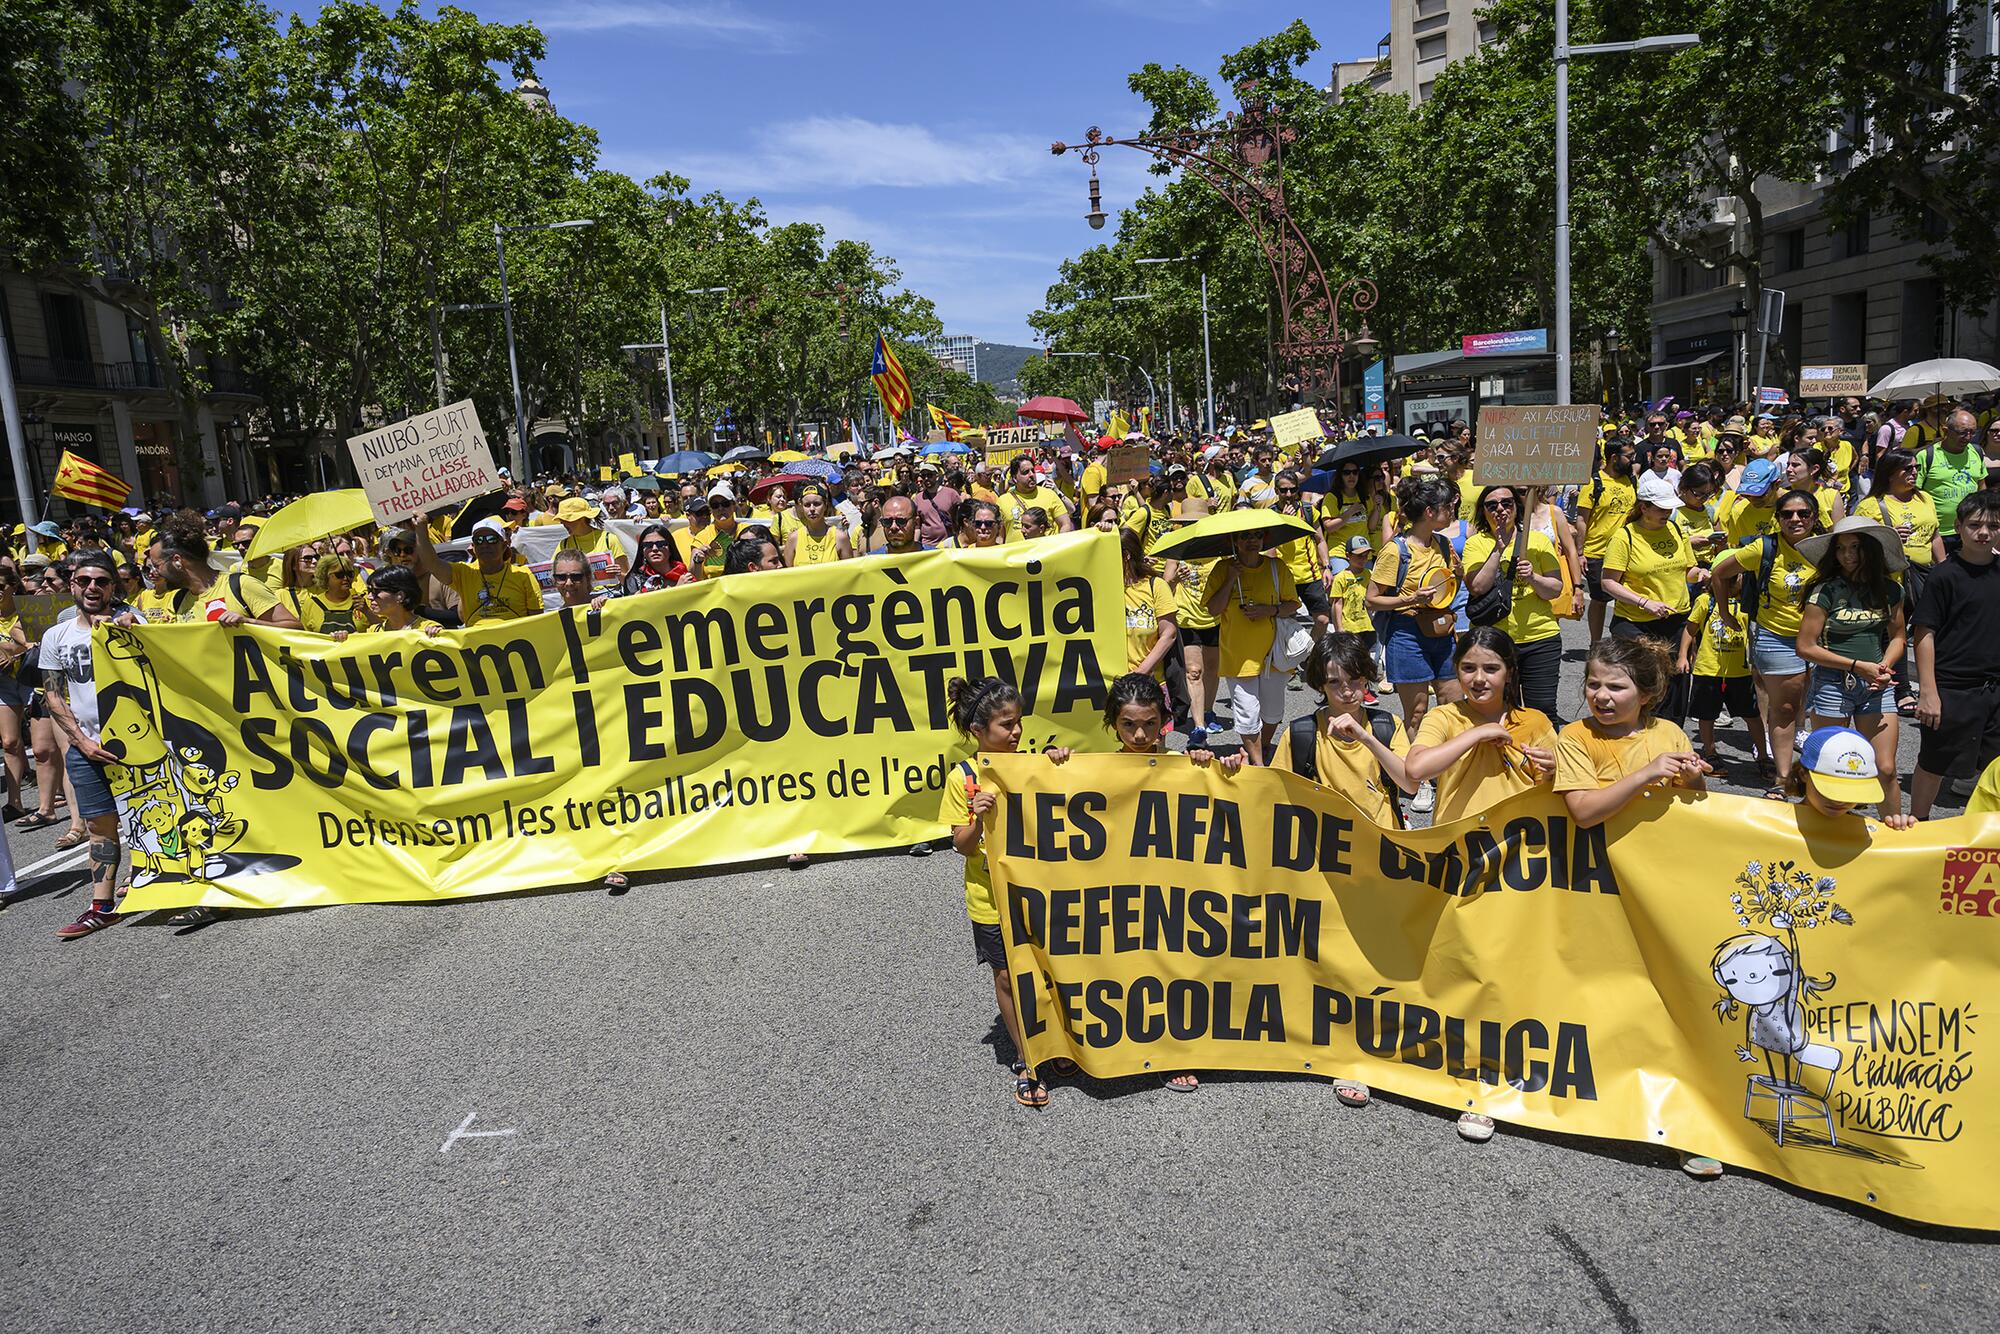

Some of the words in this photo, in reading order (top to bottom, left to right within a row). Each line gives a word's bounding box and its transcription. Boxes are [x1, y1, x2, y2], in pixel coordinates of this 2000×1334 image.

[1801, 383, 1819, 392] VAGA
[1822, 383, 1863, 392] ASSEGURADA
[54, 432, 92, 442] MANGO
[424, 407, 469, 440] SURT
[1484, 427, 1496, 440] LA
[135, 445, 170, 455] PANDORA
[375, 454, 425, 480] DEMANA
[429, 434, 466, 463] PERDÓ
[474, 436, 483, 450] A
[1525, 444, 1541, 457] LA
[1548, 442, 1581, 457] TEBA
[378, 467, 489, 515] TREBALLADORA
[392, 477, 413, 492] LA
[422, 456, 471, 482] CLASSE
[1651, 539, 1674, 551] SOS
[232, 635, 546, 713] Aturem
[558, 560, 1095, 684] l'emergència
[240, 699, 554, 790] SOCIAL
[318, 809, 493, 849] Defensem
[504, 801, 555, 838] les
[564, 769, 816, 831] treballadores
[827, 759, 870, 798] de
[1006, 790, 1107, 862] LES
[1130, 790, 1247, 870] AFA
[1272, 803, 1353, 875] DE
[1945, 849, 2000, 863] coor
[1007, 882, 1322, 963] DEFENSEM
[1939, 893, 1978, 916] de
[1016, 970, 1286, 1048] L'ESCOLA
[1312, 983, 1598, 1101] PÚBLICA
[1808, 999, 1960, 1056] DEFENSEM
[1842, 1045, 1973, 1094] l'educació
